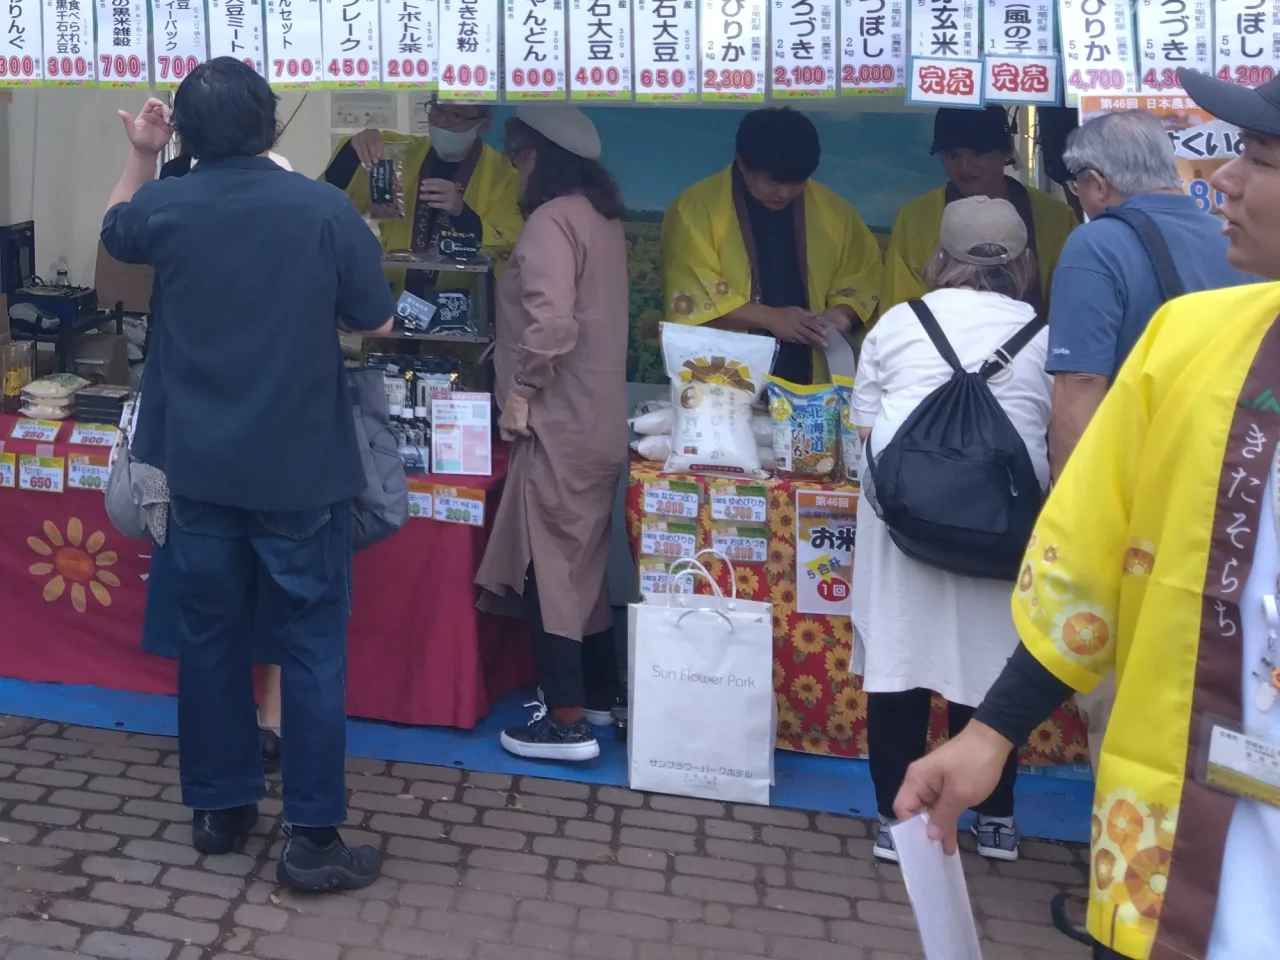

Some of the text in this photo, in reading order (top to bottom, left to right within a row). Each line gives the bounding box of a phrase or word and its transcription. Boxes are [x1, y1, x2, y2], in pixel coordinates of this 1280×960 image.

[56, 0, 69, 54] 黒千石大豆
[47, 56, 87, 76] 300
[100, 54, 141, 77] 700
[273, 58, 313, 77] 700
[328, 58, 370, 77] 450
[387, 58, 430, 77] 200
[442, 64, 488, 86] 400
[575, 65, 620, 86] 400
[773, 65, 826, 87] 2,100
[841, 64, 895, 86] 2,000
[511, 67, 556, 87] 600
[639, 68, 686, 88] 650
[703, 68, 756, 89] 2,300
[918, 65, 974, 96] 完売
[991, 62, 1049, 93] 完売
[1067, 68, 1125, 92] 4,700
[809, 407, 826, 453] 北海道
[30, 476, 52, 489] 650
[1214, 423, 1267, 637] きたそらち
[652, 665, 756, 689] Sun Flower Park
